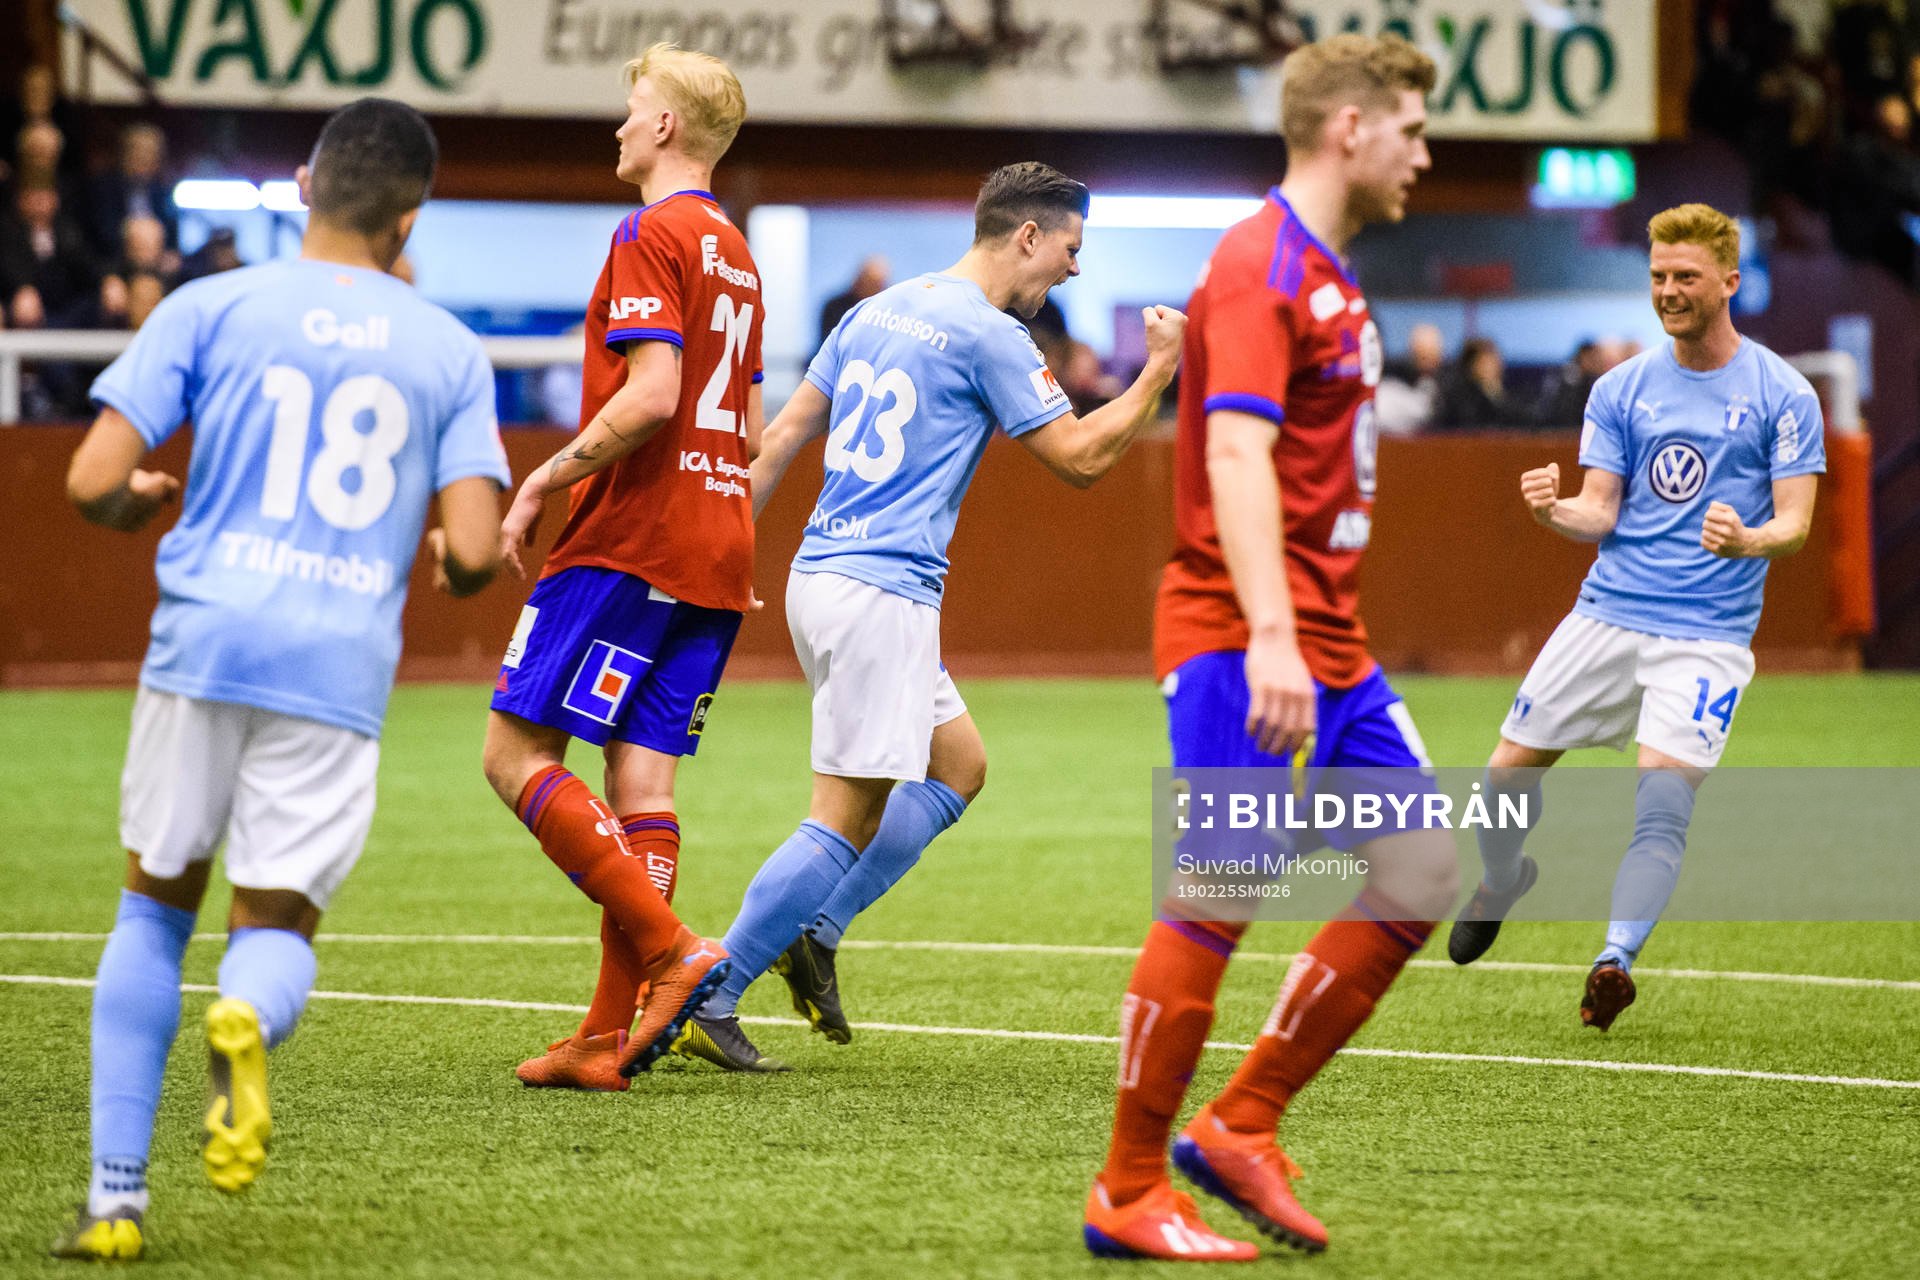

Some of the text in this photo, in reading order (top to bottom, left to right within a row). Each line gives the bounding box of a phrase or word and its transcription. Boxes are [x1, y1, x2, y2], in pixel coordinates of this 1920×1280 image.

[303, 308, 391, 349] Gall
[855, 305, 949, 351] Antonsson
[824, 359, 918, 483] 23
[260, 364, 410, 530] 18
[679, 450, 713, 474] ICA
[1692, 676, 1739, 733] 14
